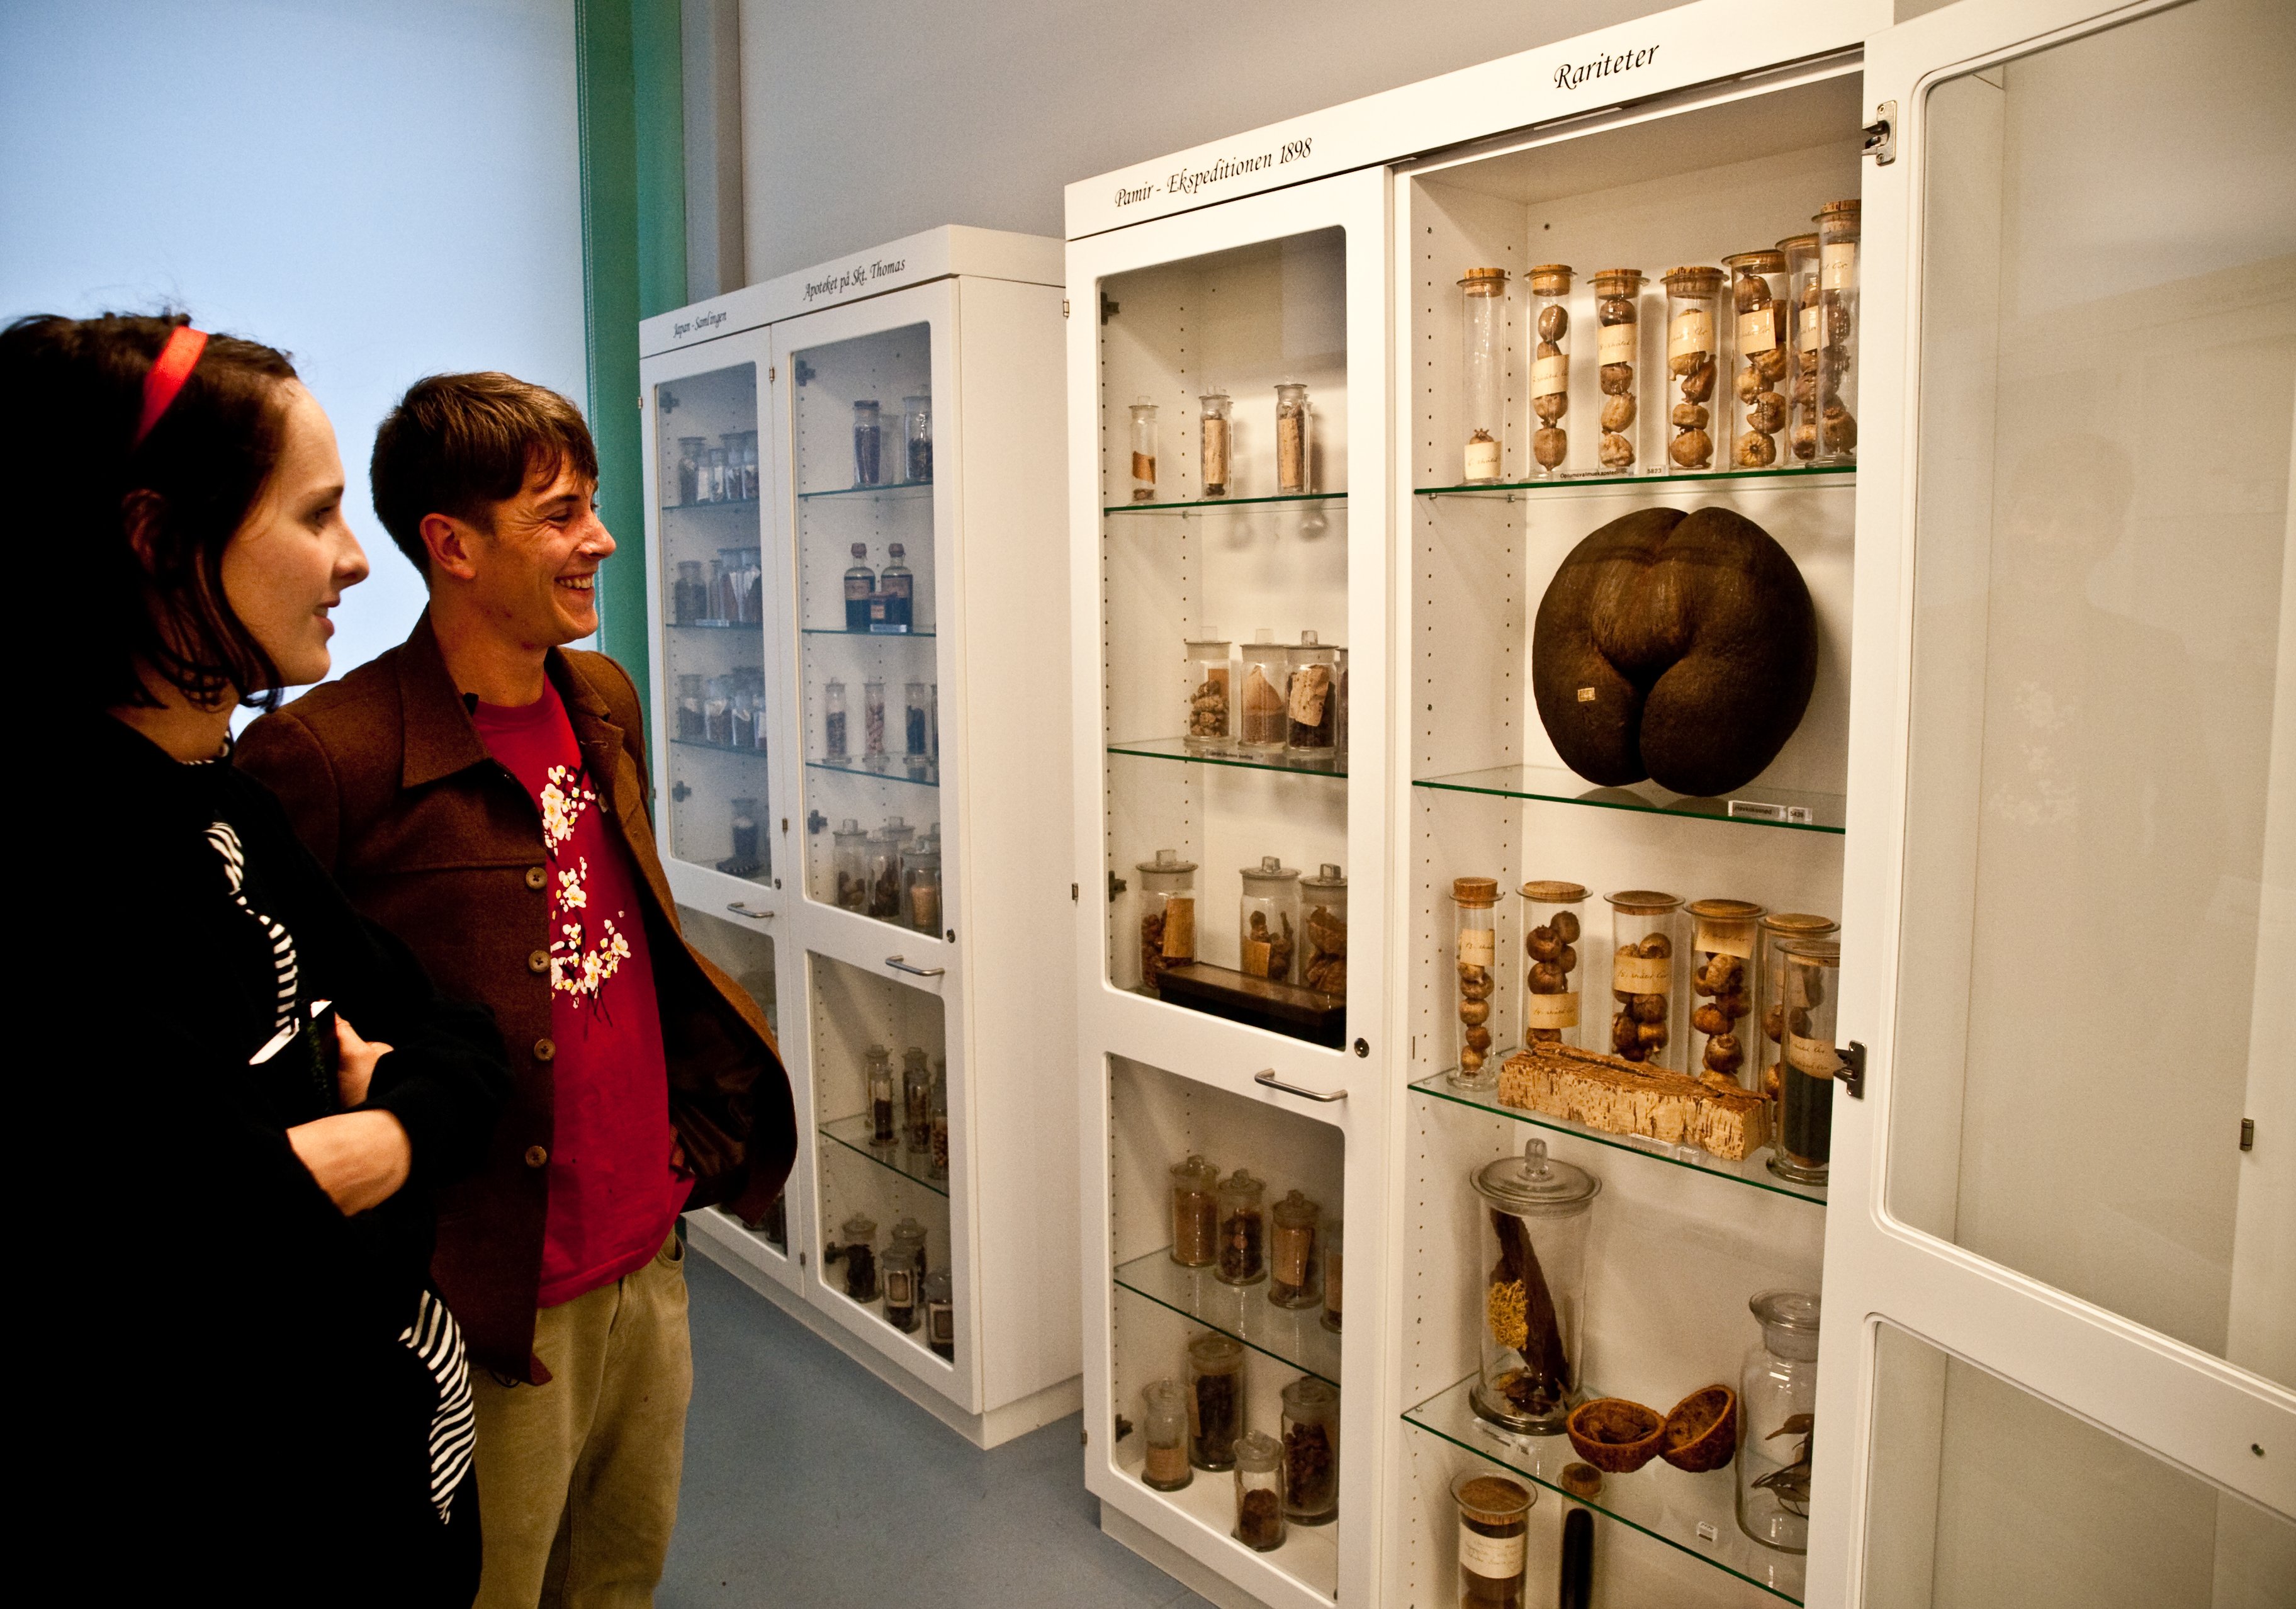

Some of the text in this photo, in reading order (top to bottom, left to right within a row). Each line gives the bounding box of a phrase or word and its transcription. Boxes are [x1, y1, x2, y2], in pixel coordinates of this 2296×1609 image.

[1553, 45, 1660, 90] Rariteter
[1167, 157, 1273, 194] Ekspeditionen
[1279, 137, 1313, 164] 1898
[802, 259, 906, 302] Apoteket på Skt. Thomas
